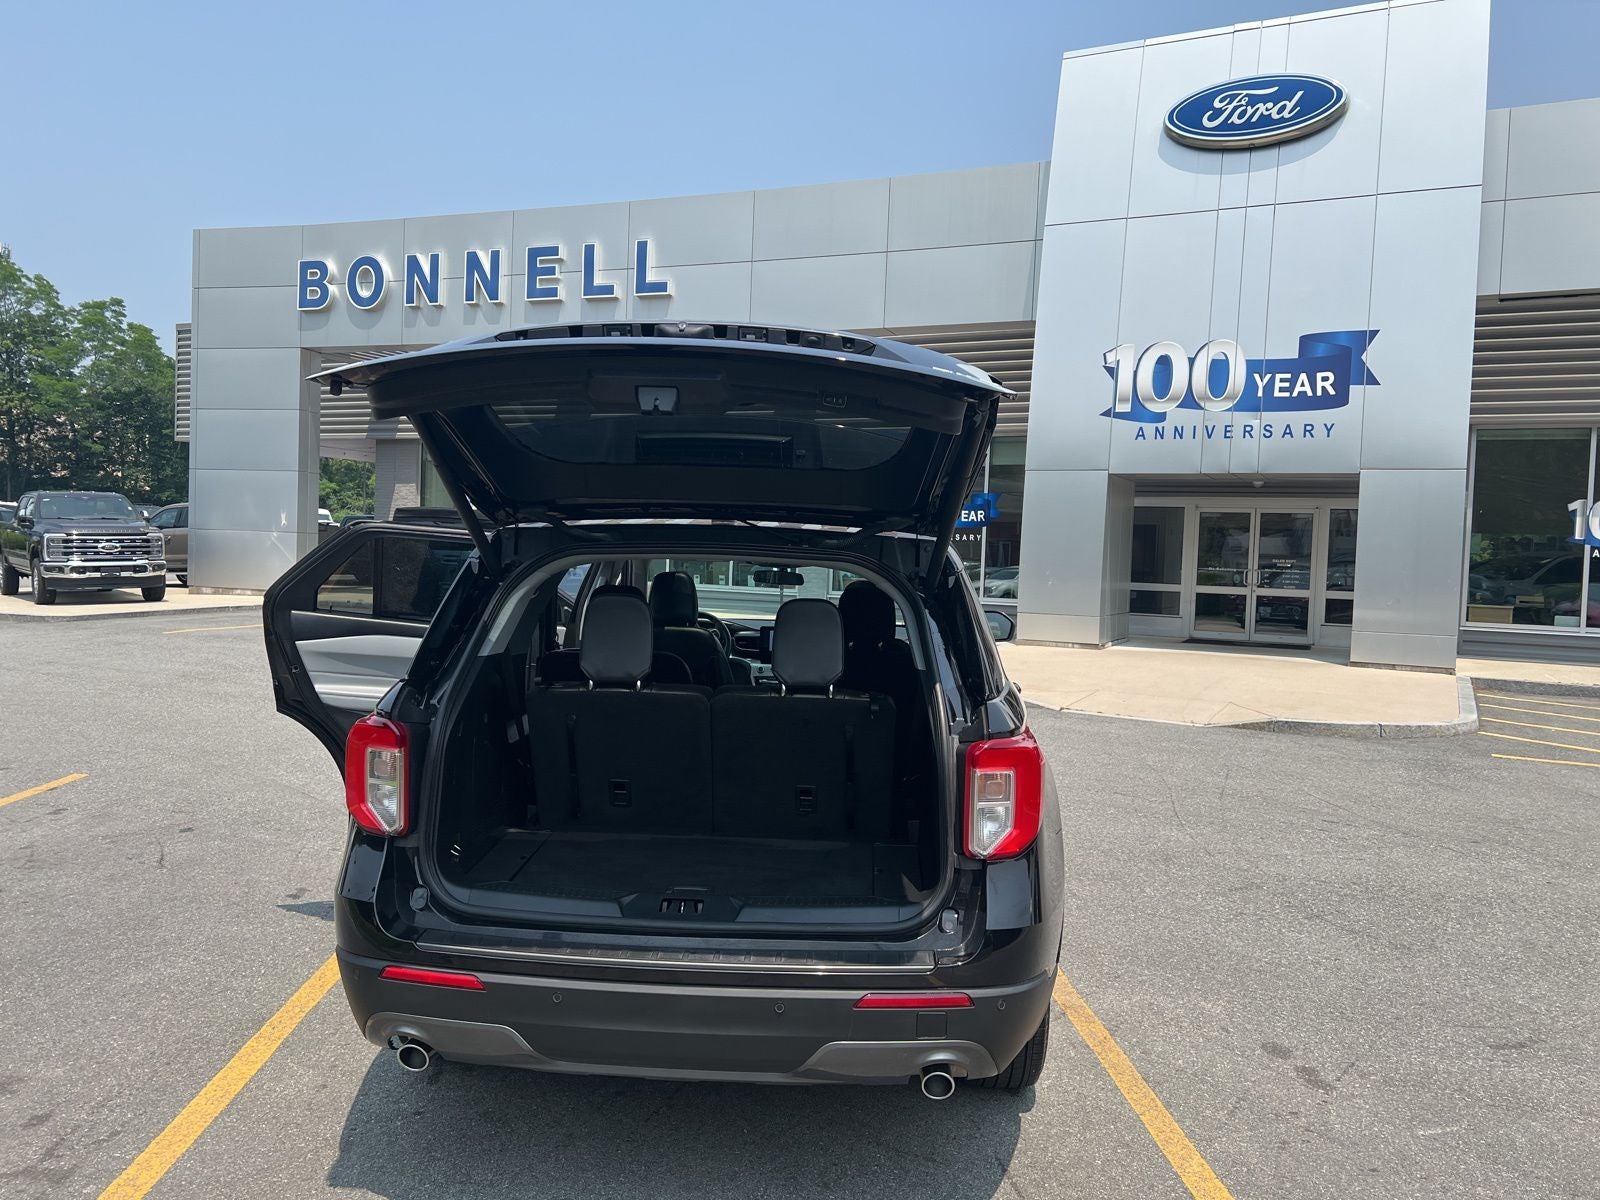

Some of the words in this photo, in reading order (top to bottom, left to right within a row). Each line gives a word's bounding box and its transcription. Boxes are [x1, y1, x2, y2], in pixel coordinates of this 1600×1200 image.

[1201, 86, 1305, 129] Ford
[297, 238, 673, 312] BONNELL
[1103, 338, 1248, 413] 100
[1253, 371, 1337, 399] YEAR
[1134, 422, 1337, 441] ANNIVERSARY
[961, 510, 985, 522] EAR
